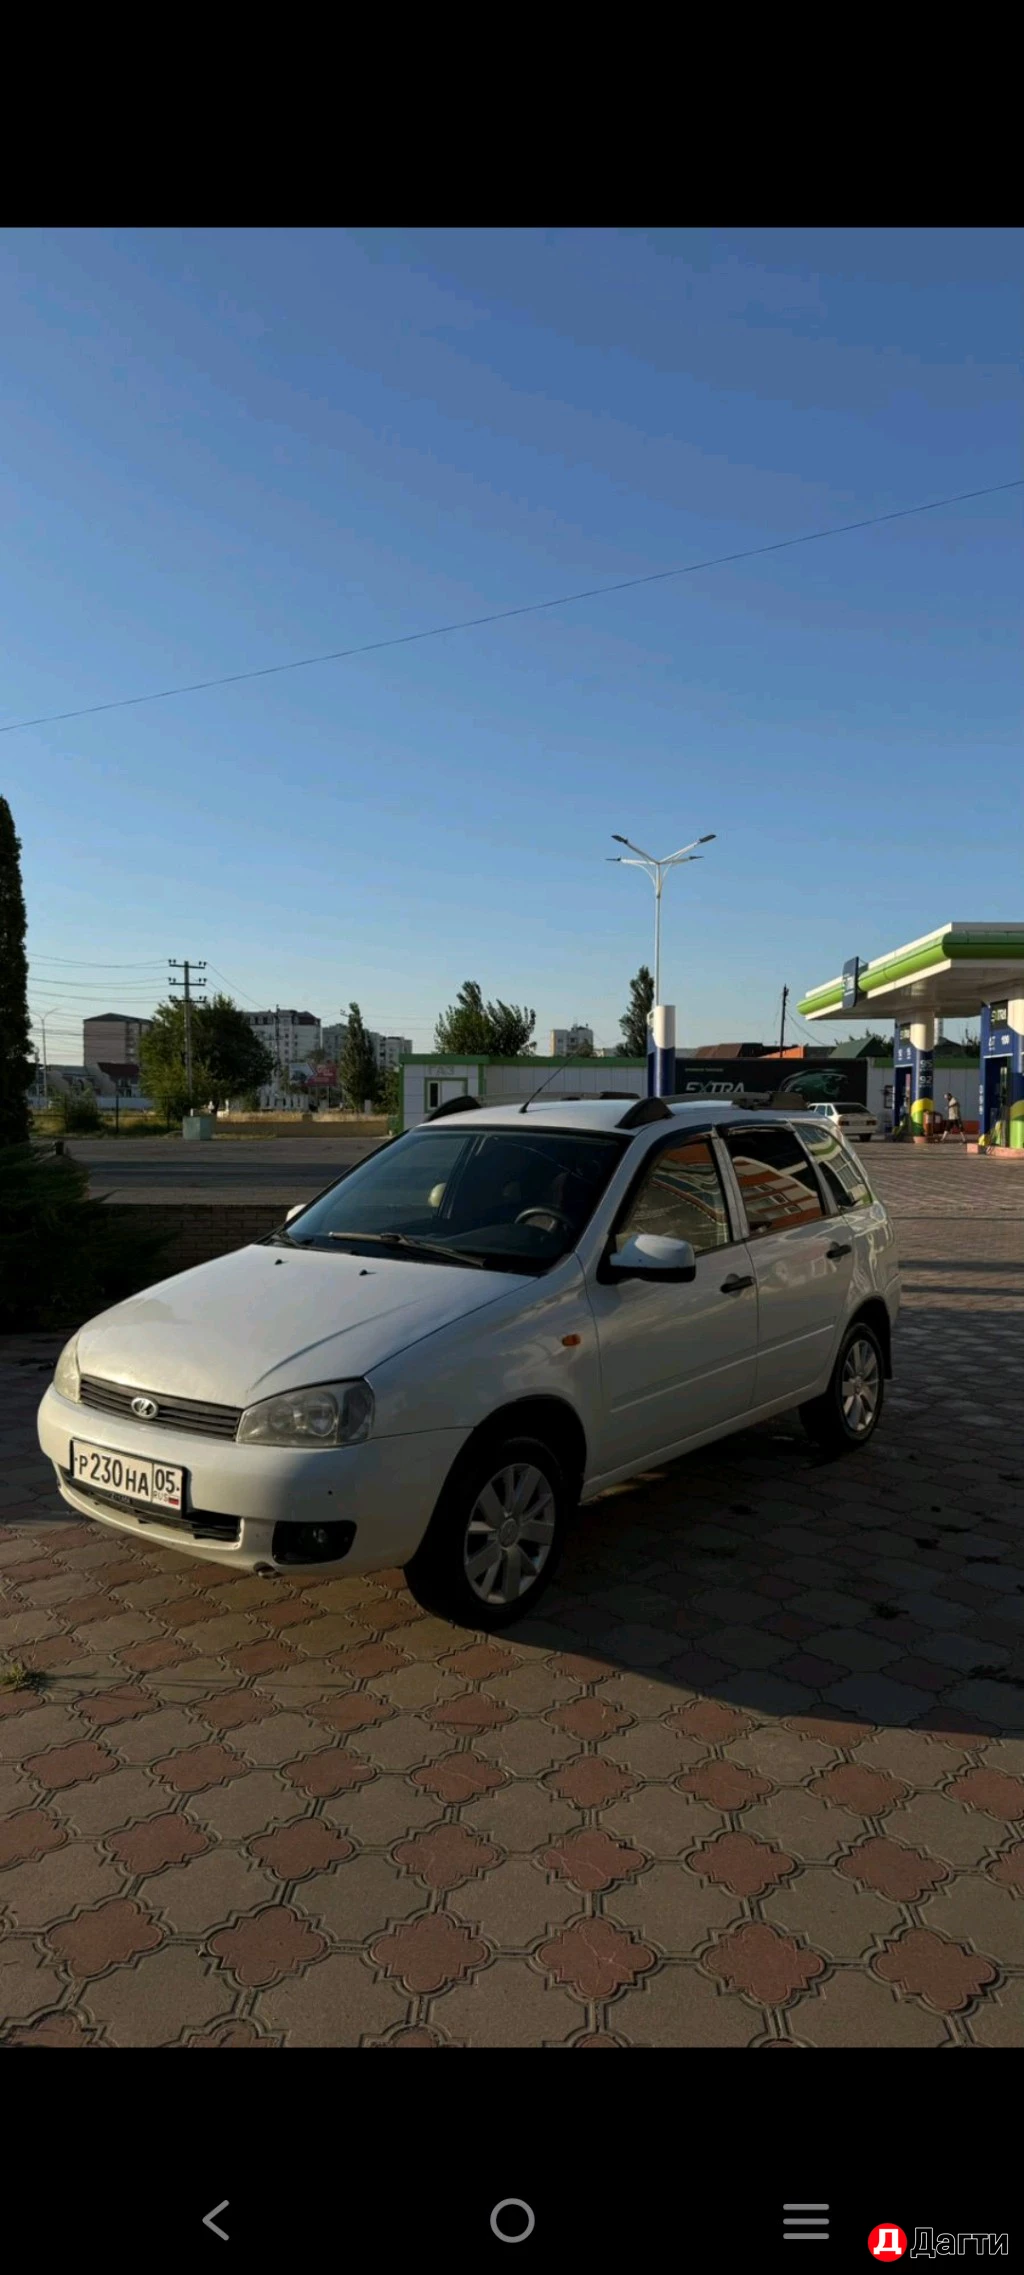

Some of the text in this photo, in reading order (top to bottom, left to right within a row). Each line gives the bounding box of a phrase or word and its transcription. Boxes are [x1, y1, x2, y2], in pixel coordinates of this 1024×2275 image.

[920, 1059, 933, 1068] 95
[428, 1064, 455, 1075] ГАЗ
[919, 1075, 932, 1084] 92
[685, 1080, 745, 1093] EXTRA
[155, 1468, 176, 1494] 05
[153, 1491, 168, 1502] RUS
